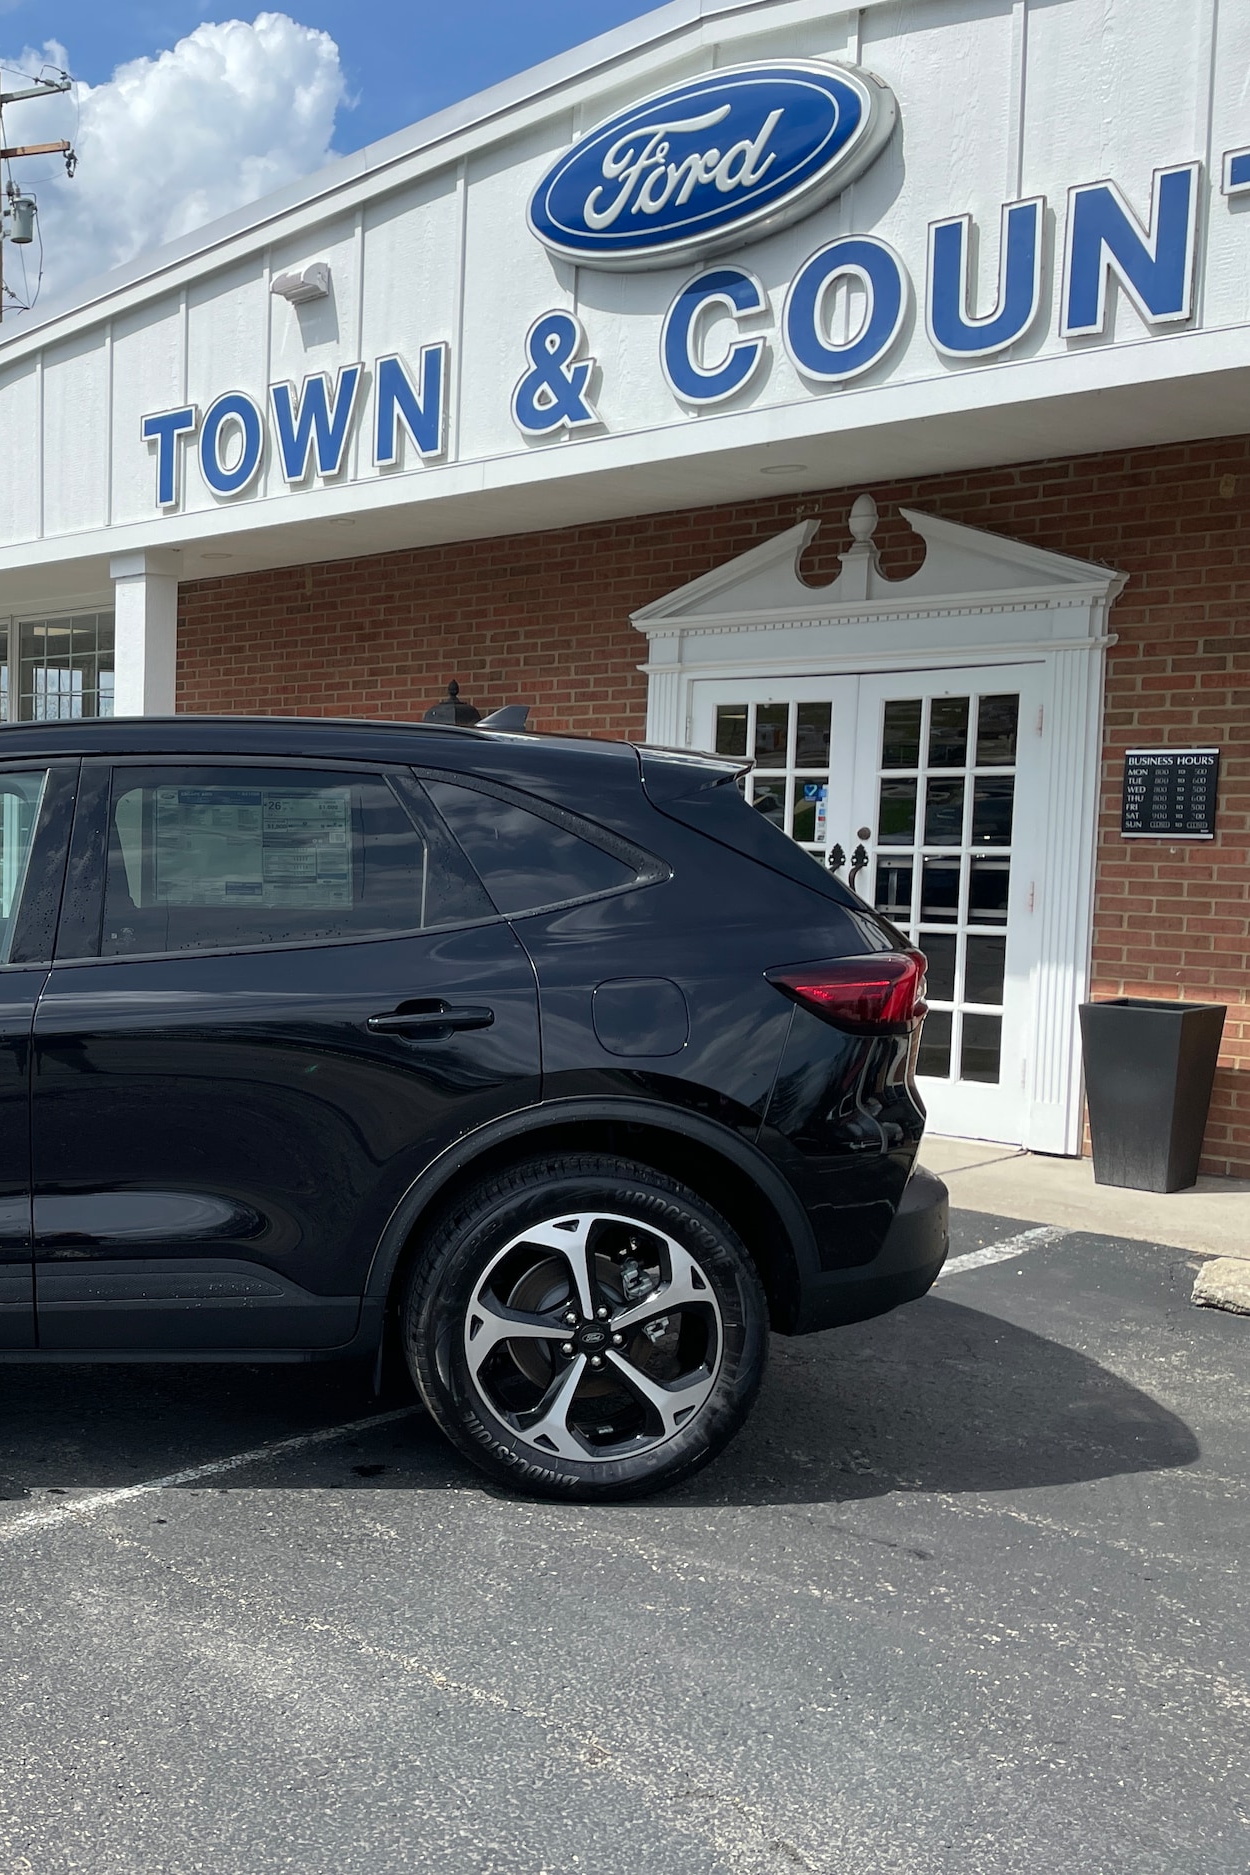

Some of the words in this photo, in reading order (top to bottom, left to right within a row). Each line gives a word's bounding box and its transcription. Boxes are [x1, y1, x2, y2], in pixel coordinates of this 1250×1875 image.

[583, 104, 785, 230] Ford
[141, 341, 449, 508] TOWN
[511, 308, 603, 437] &
[661, 150, 1250, 407] COUN
[1128, 757, 1174, 766] BUSINESS
[1177, 756, 1214, 765] HOURS
[268, 801, 282, 811] 26
[1126, 803, 1138, 811] FRI
